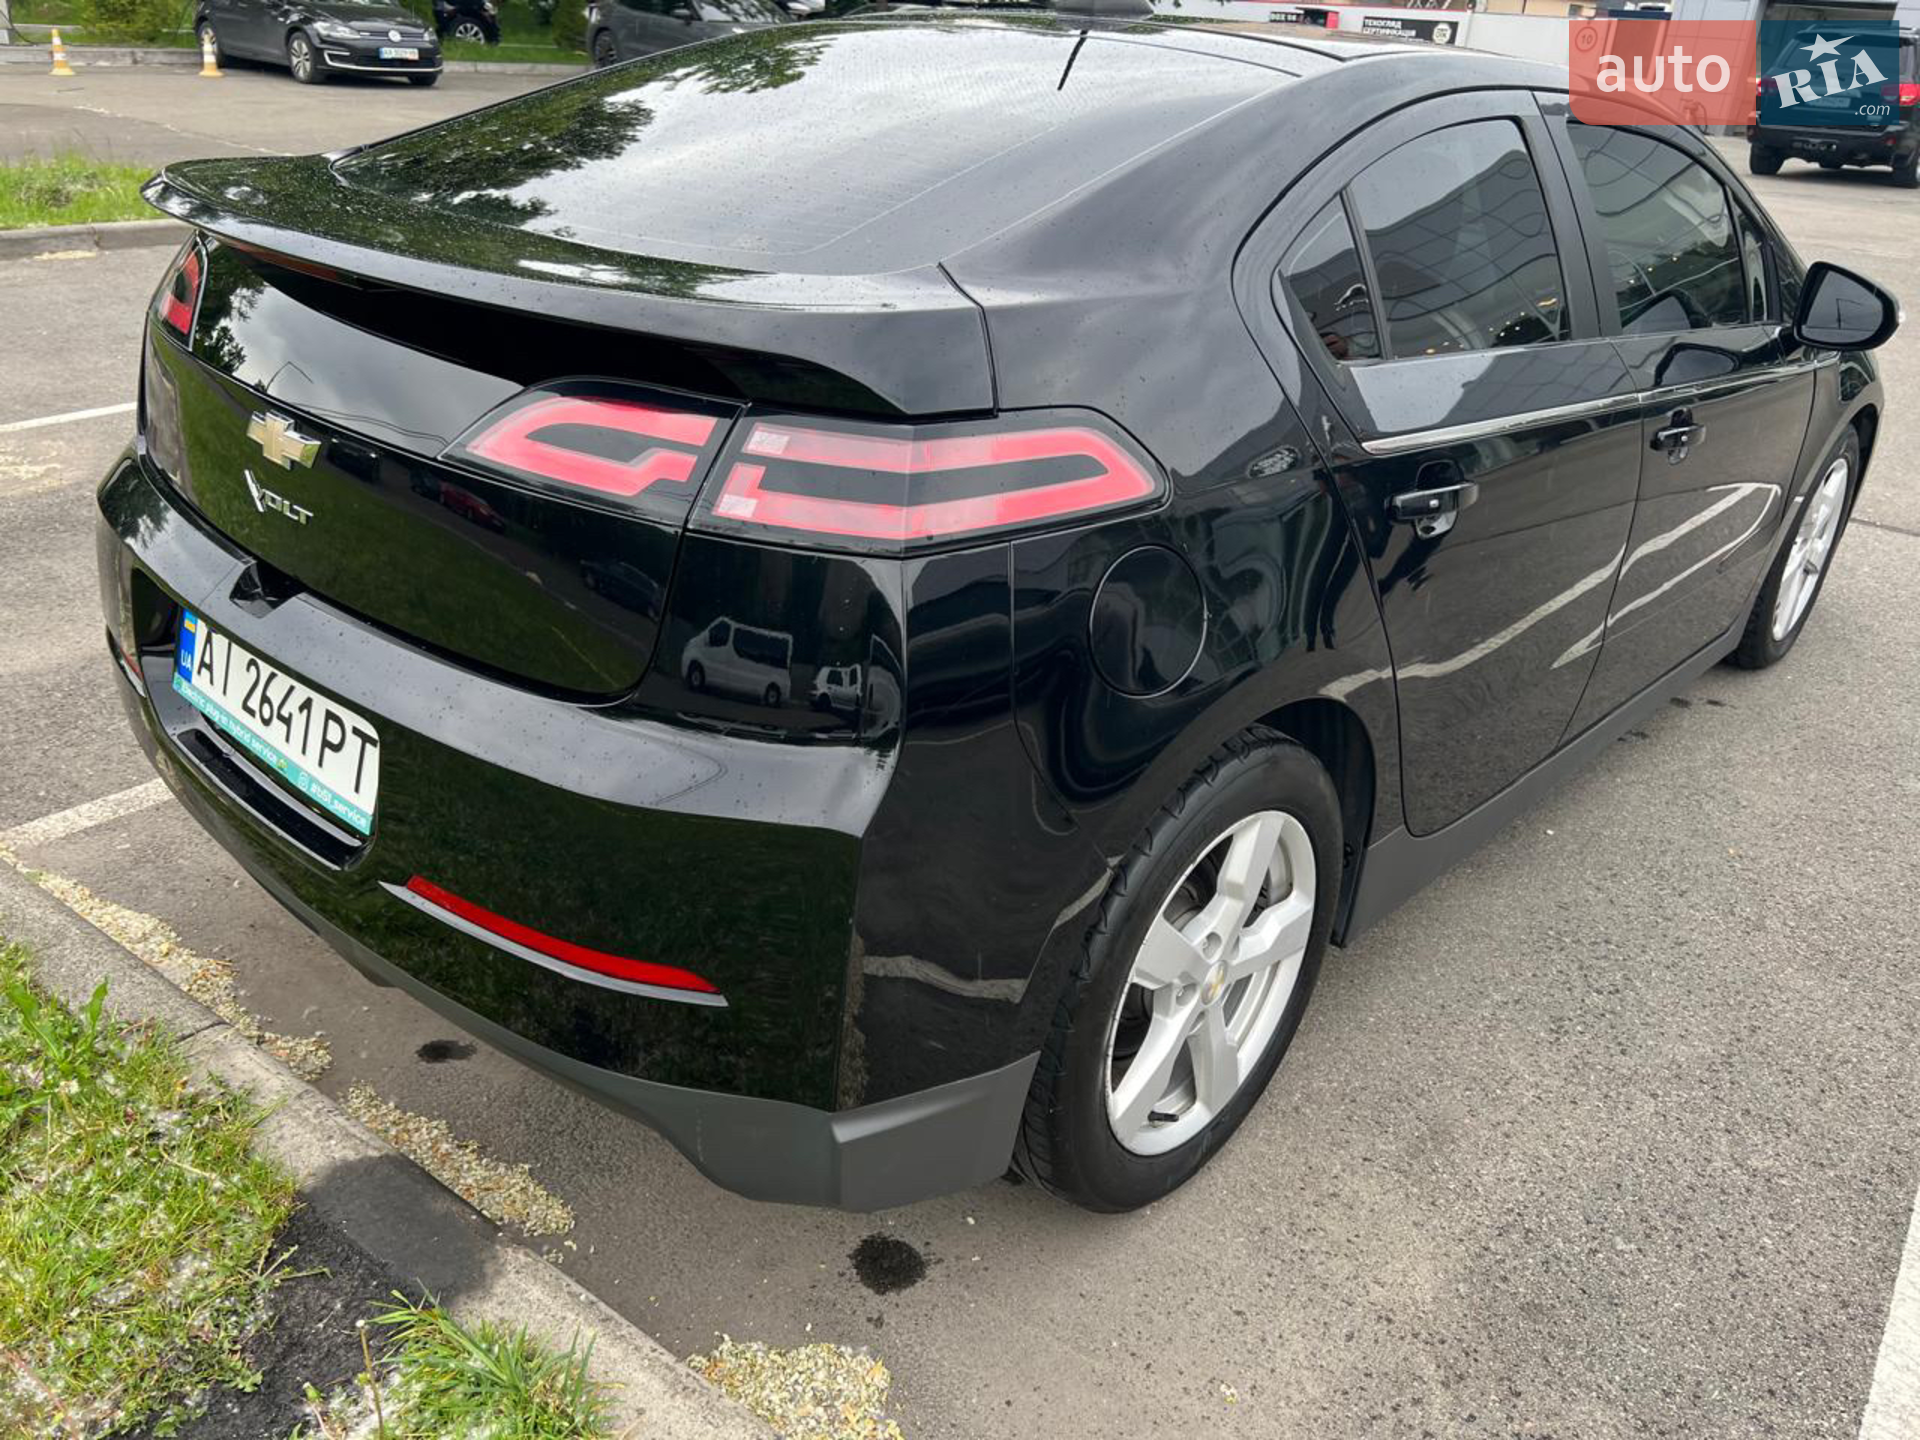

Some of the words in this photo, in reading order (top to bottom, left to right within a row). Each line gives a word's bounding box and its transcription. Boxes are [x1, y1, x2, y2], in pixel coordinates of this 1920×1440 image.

[1581, 34, 1593, 45] 10
[180, 649, 193, 671] UA
[197, 631, 232, 696] AI
[241, 658, 314, 756] 2641
[318, 708, 379, 795] PT
